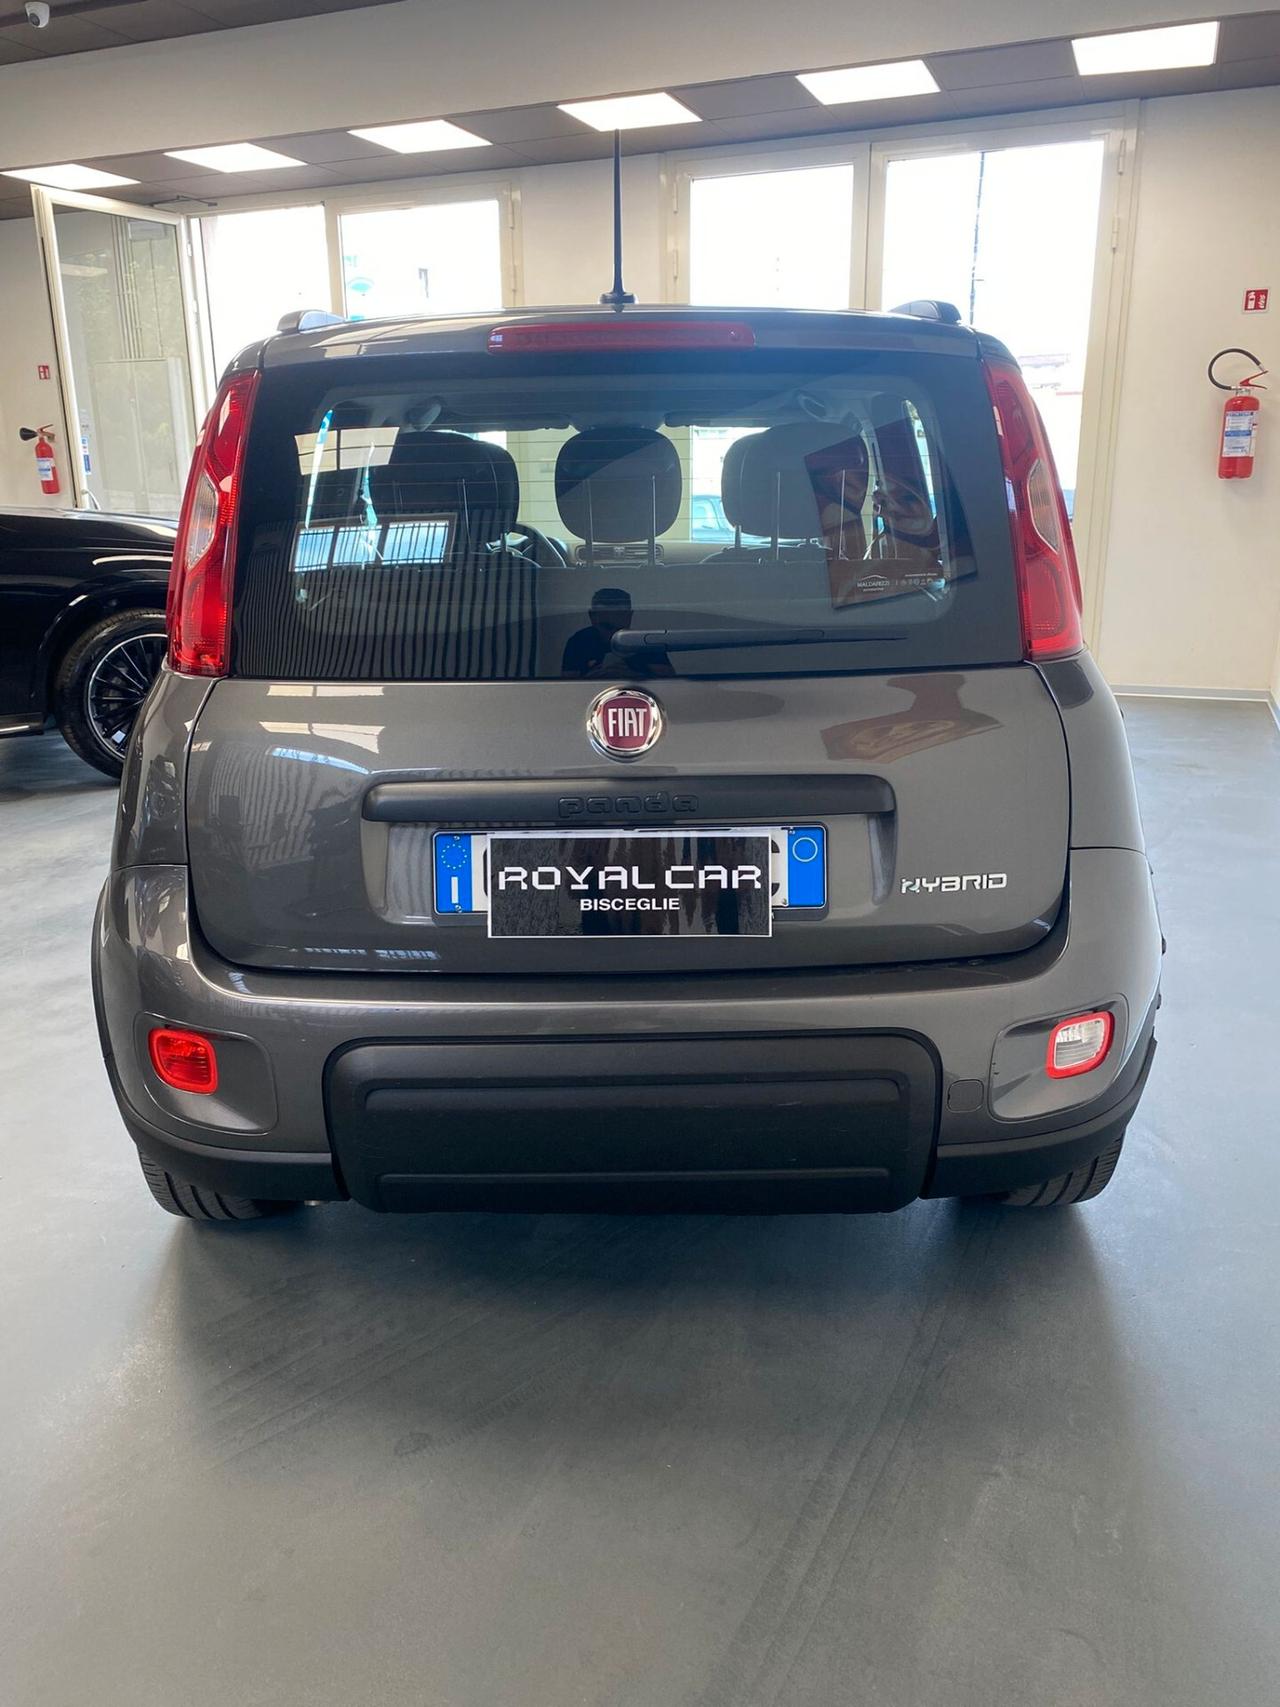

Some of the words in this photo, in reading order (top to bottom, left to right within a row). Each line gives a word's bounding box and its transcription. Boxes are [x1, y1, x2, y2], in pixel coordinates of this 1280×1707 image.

[607, 708, 647, 737] FIAT
[558, 791, 699, 818] panda
[451, 876, 459, 904] I
[498, 865, 656, 890] ROYAL
[664, 865, 762, 889] CAR
[901, 873, 1007, 894] HYBRID
[580, 898, 680, 911] BISCEGLIE
